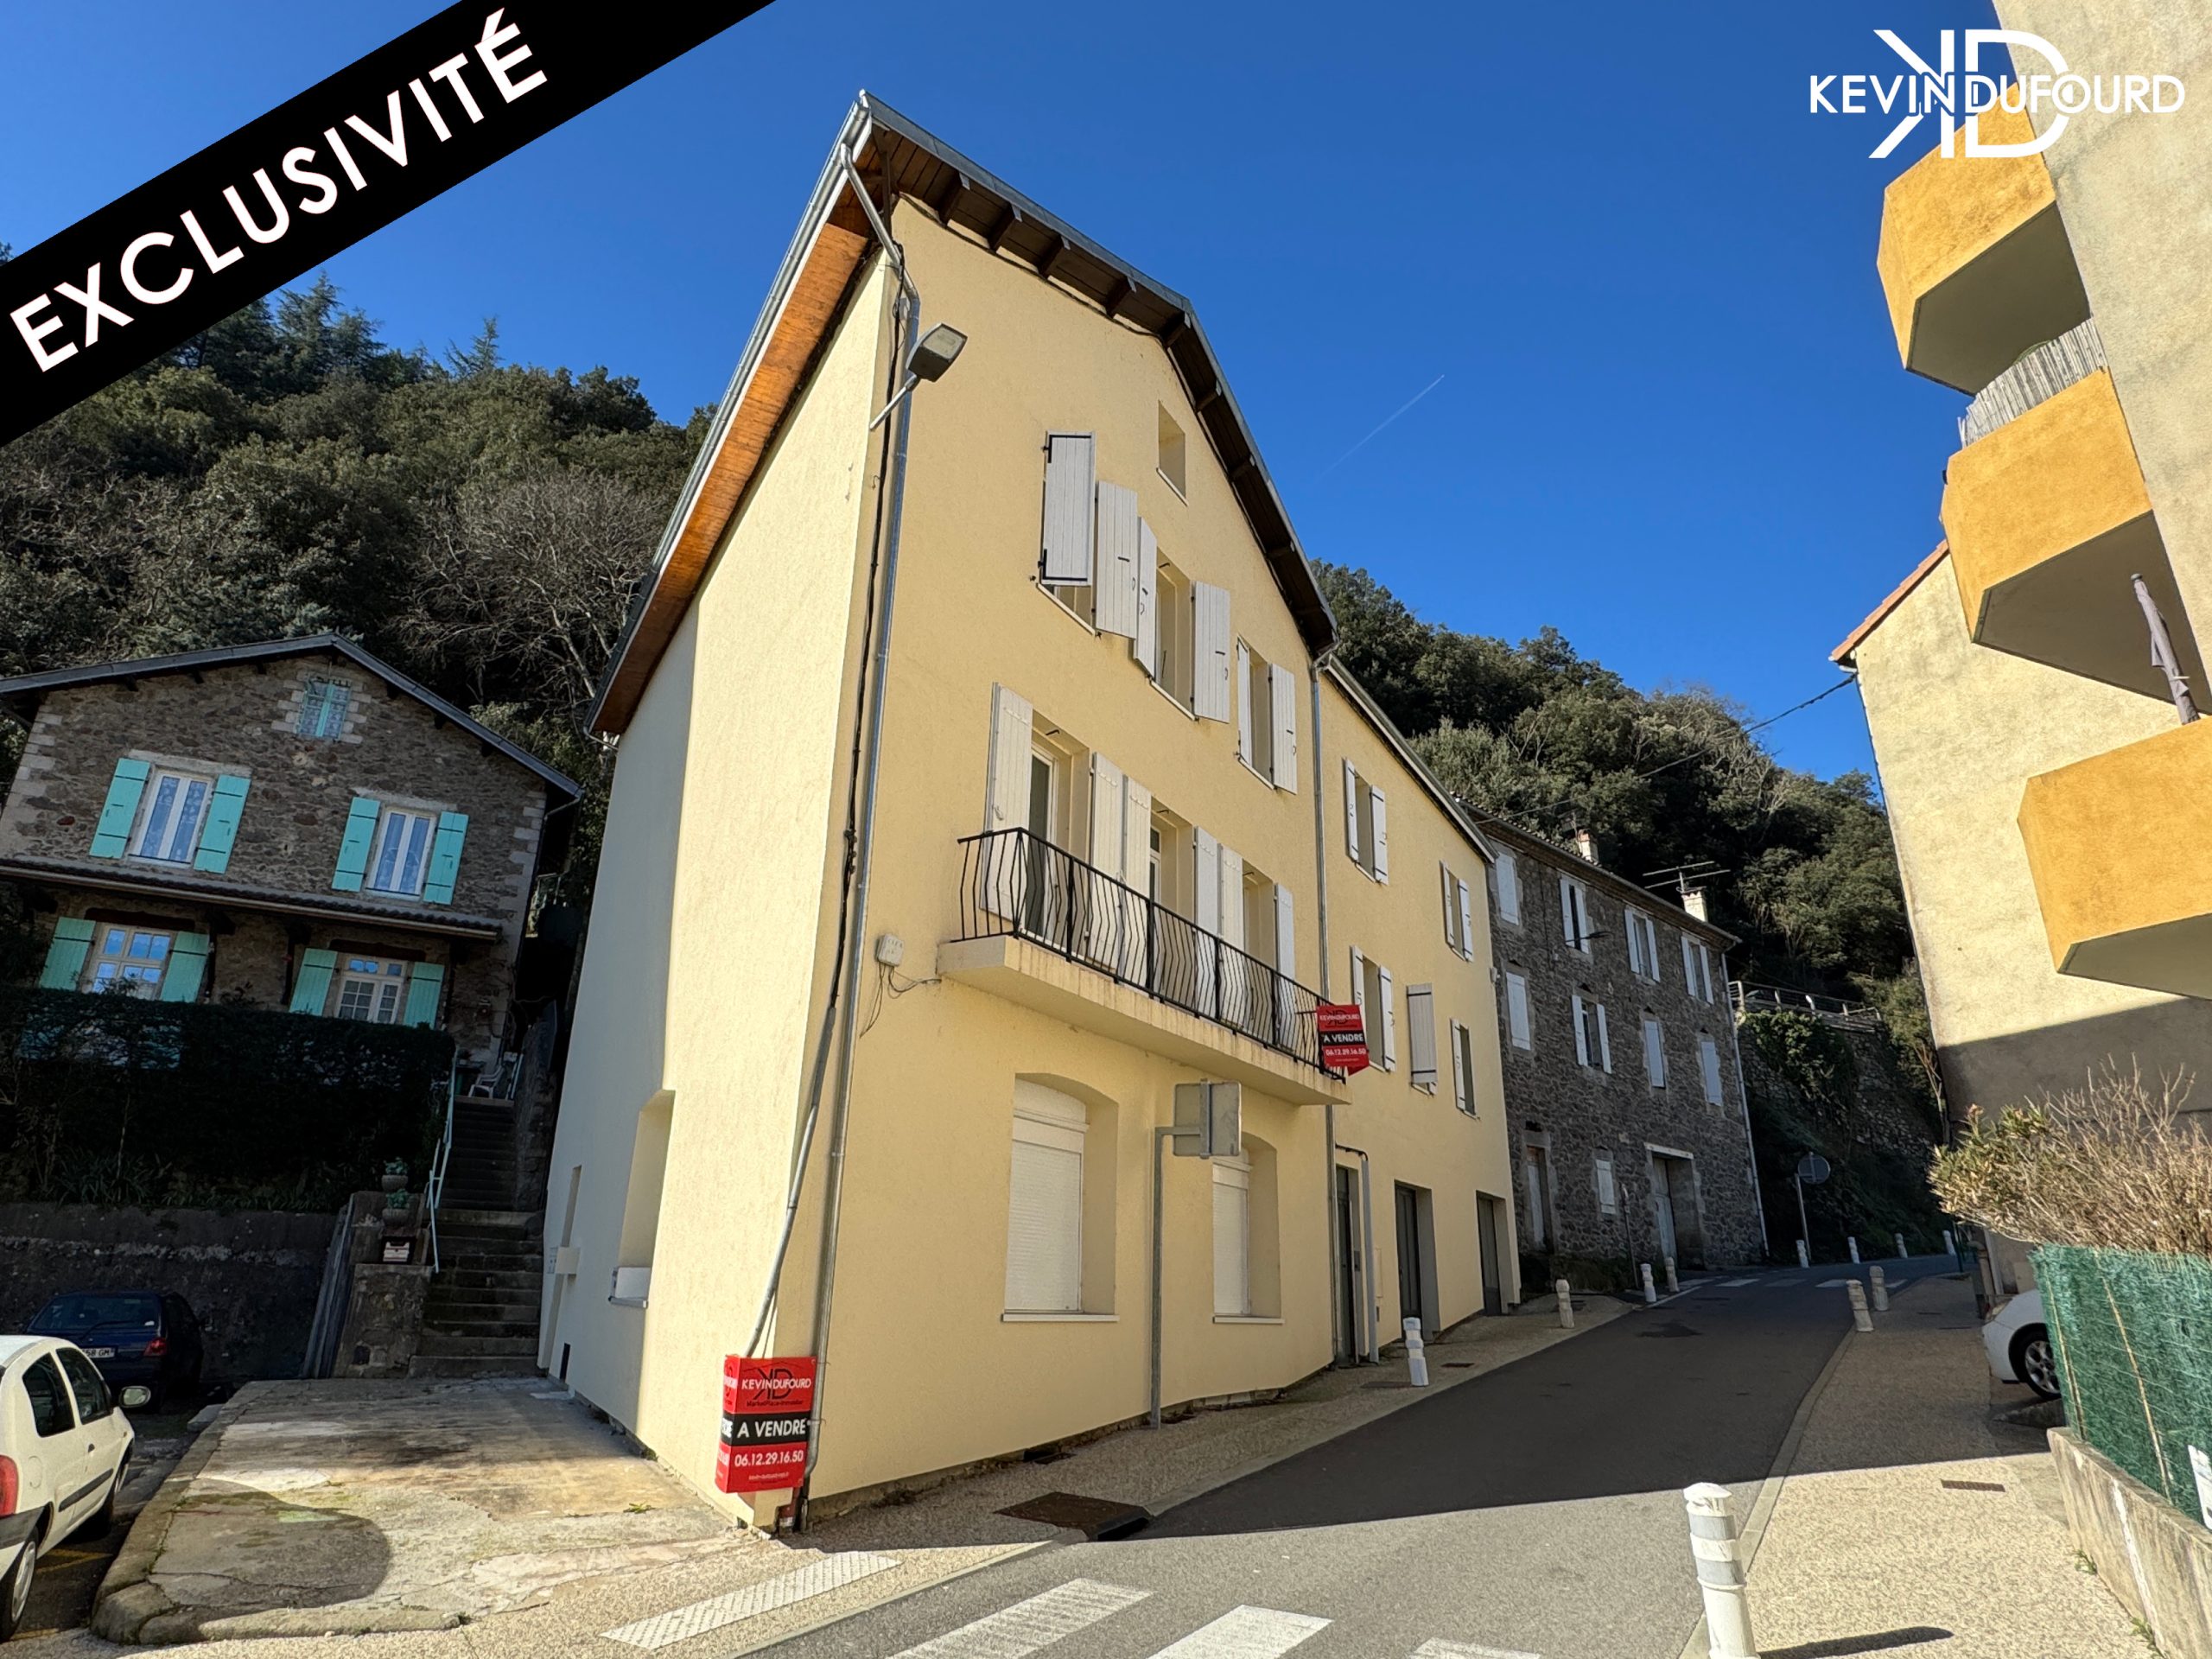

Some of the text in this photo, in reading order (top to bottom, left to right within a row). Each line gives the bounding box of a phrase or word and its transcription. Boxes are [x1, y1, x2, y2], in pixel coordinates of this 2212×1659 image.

[1324, 1033, 1363, 1043] A VENDRE
[737, 1421, 750, 1438] A
[754, 1420, 806, 1438] VENDRE
[734, 1450, 804, 1467] 06.12.29.16.50
